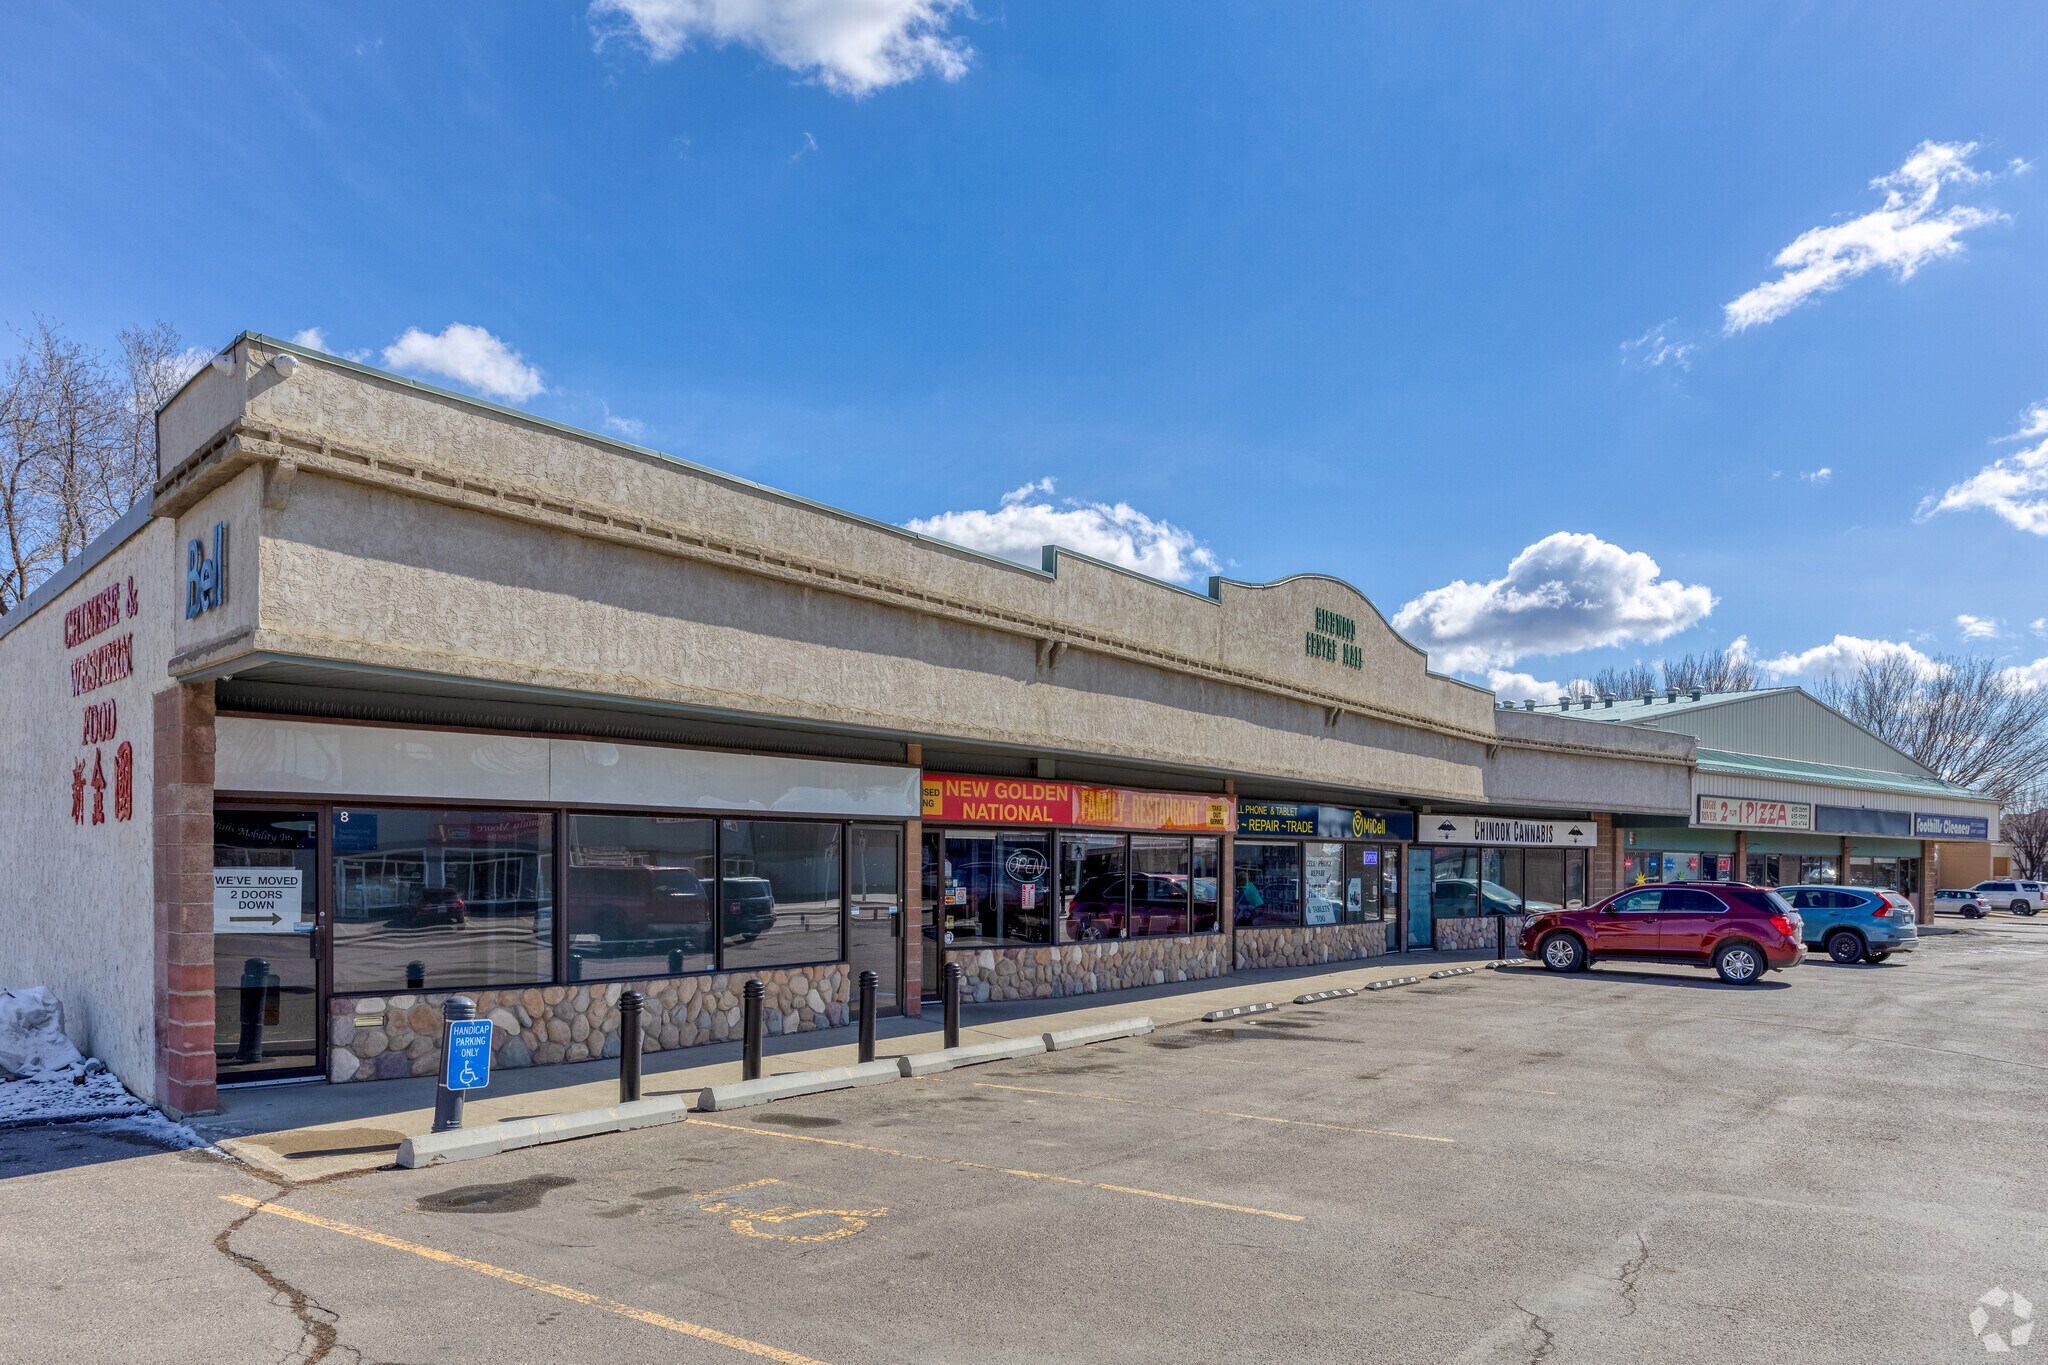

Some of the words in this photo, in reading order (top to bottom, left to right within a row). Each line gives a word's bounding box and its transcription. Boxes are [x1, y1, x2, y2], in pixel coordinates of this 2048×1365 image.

[186, 520, 224, 620] Bell
[64, 582, 120, 649] CHINESE
[126, 575, 138, 619] &
[1306, 631, 1337, 661] CENTRE
[1342, 642, 1364, 669] MALL
[71, 632, 133, 697] WESTERN
[82, 698, 118, 745] FOOD
[923, 788, 940, 797] SED
[945, 779, 990, 798] NEW
[994, 782, 1068, 802] GOLDEN
[923, 799, 935, 808] NG
[1081, 789, 1126, 823] FAMILY
[1131, 794, 1200, 827] RESTAURANT
[1702, 800, 1717, 810] HIGH
[340, 811, 349, 823] 8
[963, 802, 1054, 823] NATIONAL
[1245, 804, 1268, 815] PHONE
[1270, 805, 1275, 815] &
[1276, 806, 1298, 817] TABLET
[1702, 811, 1717, 822] RIVER
[1720, 801, 1728, 822] 2
[1745, 801, 1787, 826] PIZZA
[1248, 819, 1280, 832] REPAIR
[1363, 817, 1386, 835] MiCell
[1474, 818, 1511, 842] CHINOOK
[1514, 820, 1554, 843] CANNABIS
[1916, 818, 1942, 833] Foothills
[1943, 819, 1970, 835] Cleaners
[237, 827, 278, 842] Mobility
[1365, 853, 1377, 863] OPEN
[1008, 857, 1044, 875] OPEN
[1310, 869, 1326, 877] REPAIR
[215, 876, 252, 885] WE'VE
[258, 876, 299, 886] MOVED
[230, 890, 238, 899] 2
[241, 890, 283, 899] DOORS
[238, 901, 275, 910] DOWN
[1312, 905, 1331, 913] TABLETS
[453, 1025, 489, 1036] HANDICAP
[455, 1036, 486, 1047] PARKING
[461, 1047, 480, 1058] ONLY
